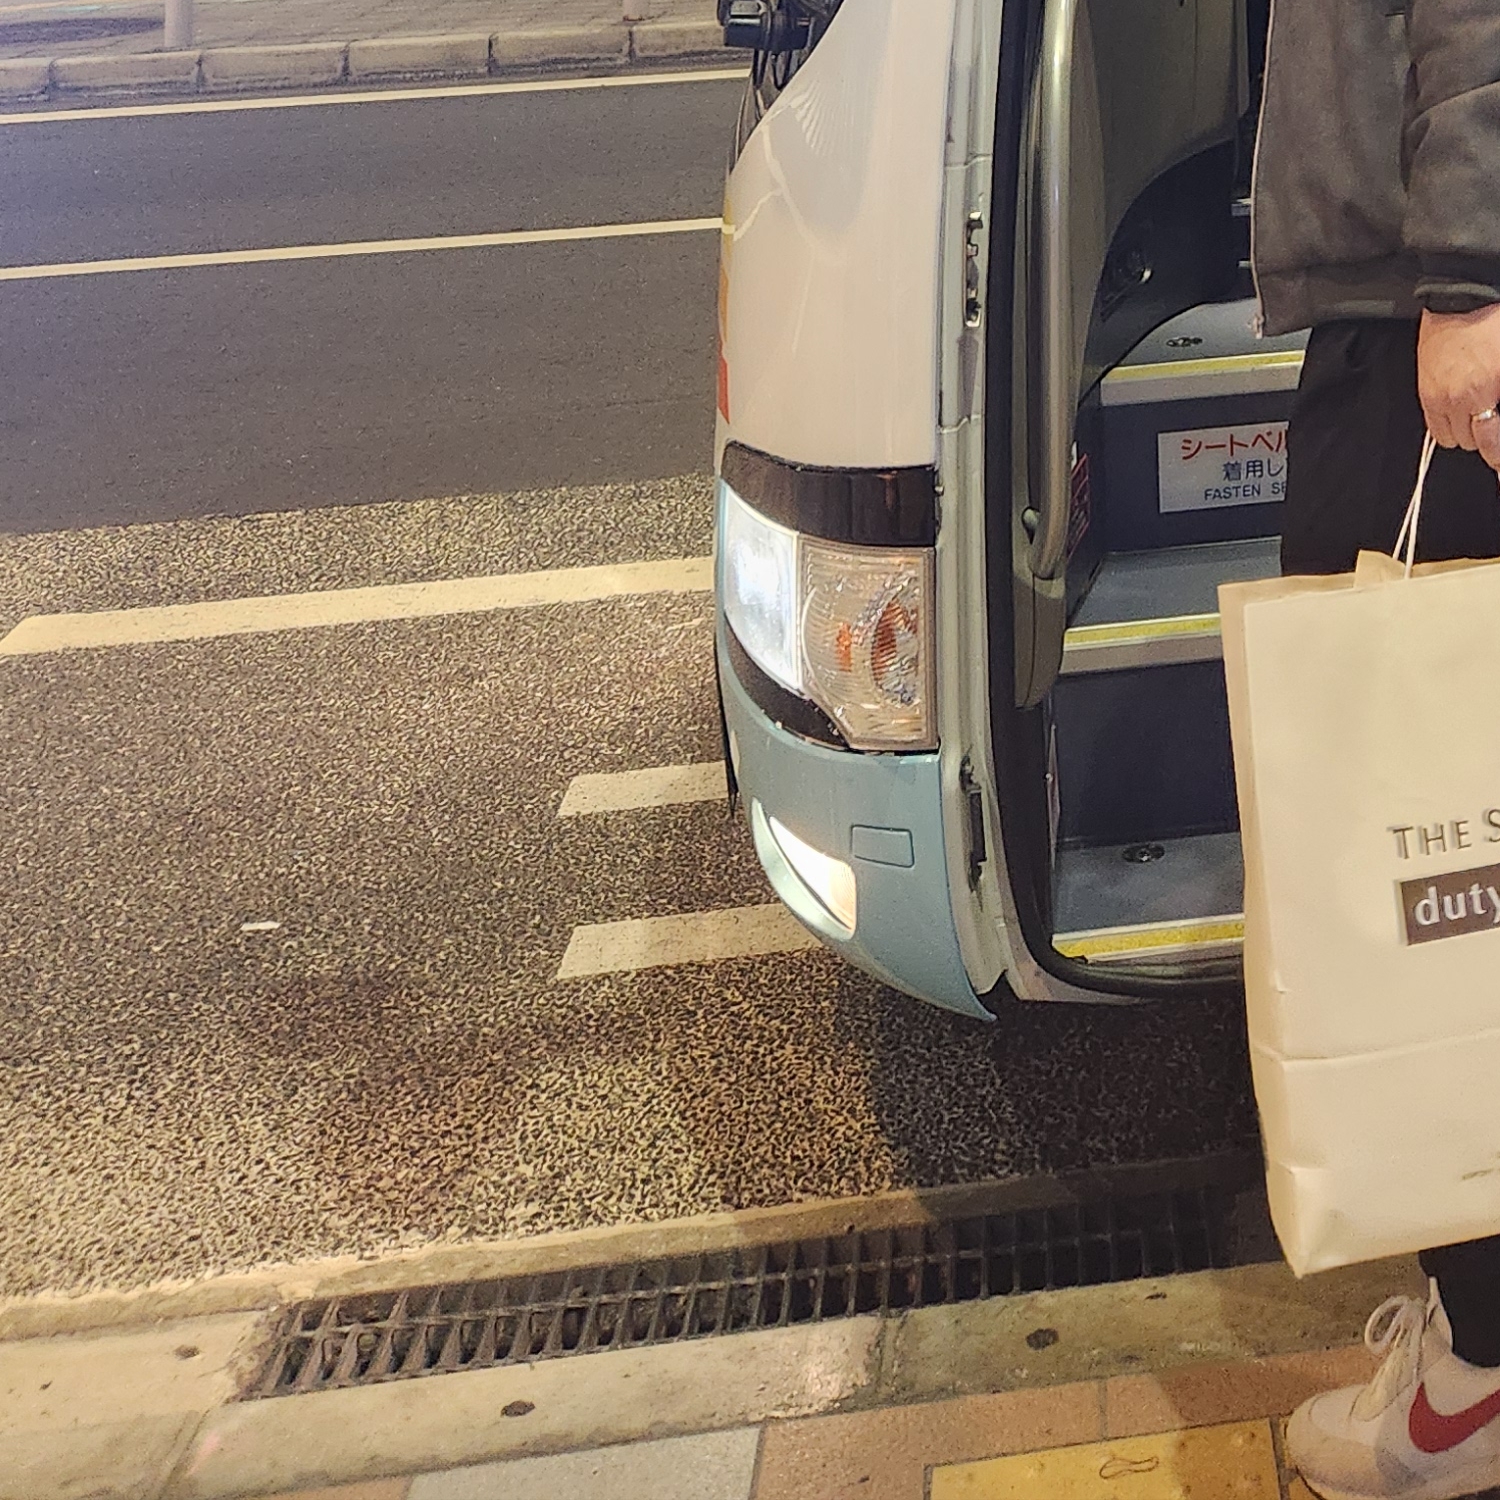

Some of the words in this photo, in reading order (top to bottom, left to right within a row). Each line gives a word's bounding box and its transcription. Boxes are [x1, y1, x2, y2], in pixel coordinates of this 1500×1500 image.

[1223, 459, 1284, 481] 着用し
[1204, 484, 1262, 501] FASTEN
[1391, 820, 1472, 859] THE
